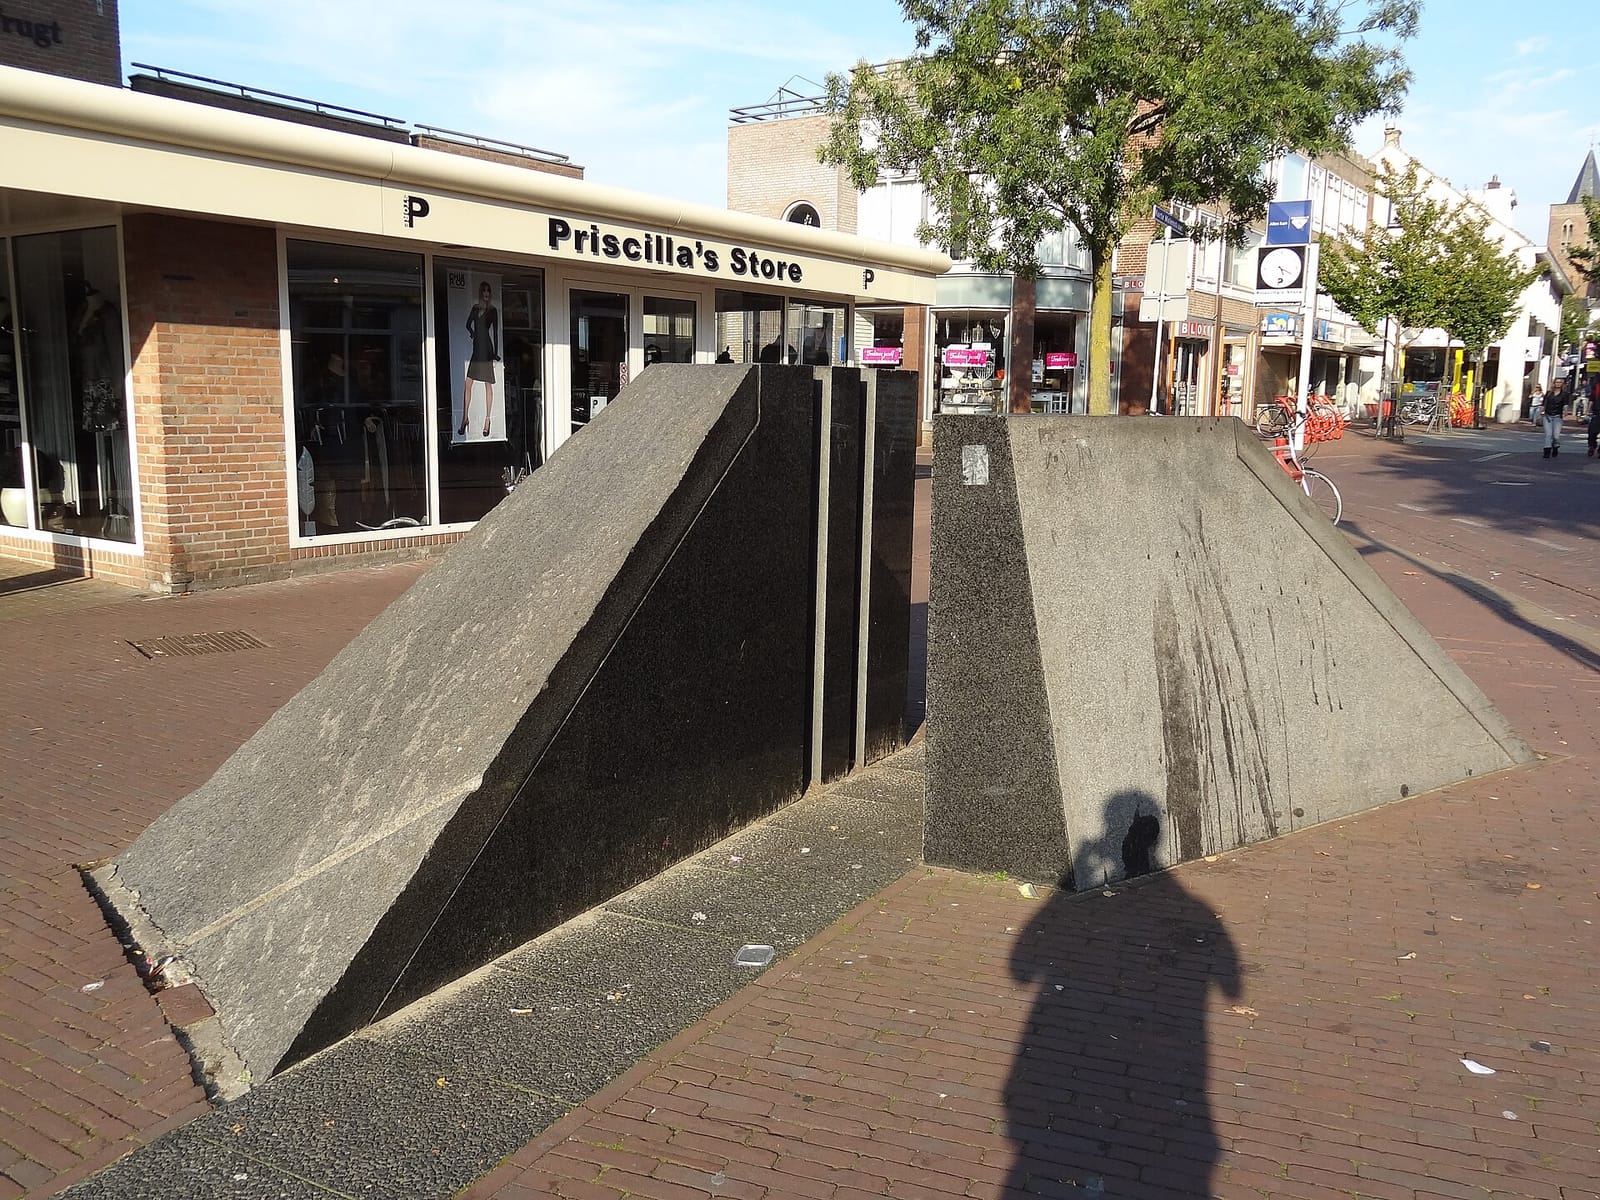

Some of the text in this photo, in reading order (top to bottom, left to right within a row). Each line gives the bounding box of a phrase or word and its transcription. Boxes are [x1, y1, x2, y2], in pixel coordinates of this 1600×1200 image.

[0, 11, 62, 48] rugt
[408, 195, 430, 228] P
[548, 217, 803, 282] Priscilla's Store
